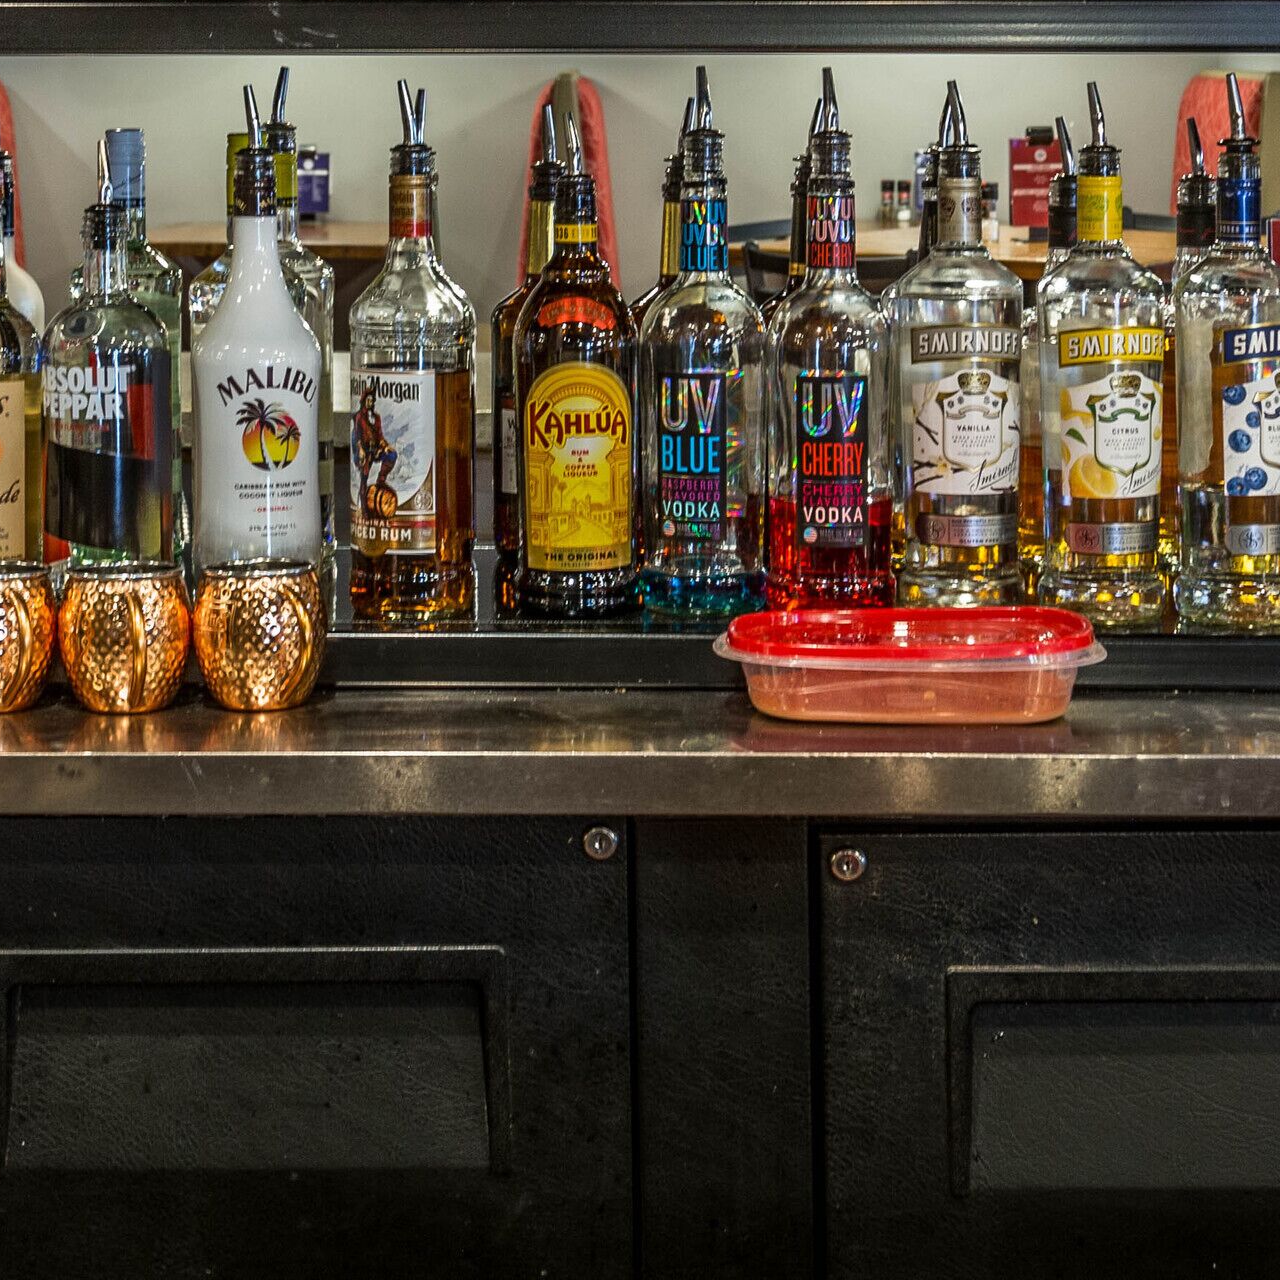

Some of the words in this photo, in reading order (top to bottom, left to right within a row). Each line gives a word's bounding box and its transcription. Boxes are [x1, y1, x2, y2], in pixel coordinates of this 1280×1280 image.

[811, 244, 854, 267] CHERRY
[919, 329, 1018, 355] SMIRNOFF
[42, 364, 136, 394] BSOLUT
[215, 365, 317, 407] MALIBU
[367, 375, 421, 404] Morgan
[42, 393, 124, 421] PEPPAR
[661, 377, 721, 435] UV
[801, 379, 864, 438] UV
[528, 399, 629, 448] KAHLÚA
[956, 424, 992, 433] VANILLA
[1111, 427, 1140, 437] CITRUS
[570, 449, 590, 457] RUM
[661, 435, 720, 474] BLUE
[802, 441, 864, 476] CHERRY
[562, 470, 599, 478] LIQUEUR
[234, 482, 274, 490] CARIBBEAN
[275, 481, 291, 489] RUM
[662, 478, 721, 491] RASPBERRY
[802, 483, 862, 497] CHERRY
[277, 489, 303, 499] LIQUEUR
[662, 490, 721, 502] FLAVORED
[662, 501, 721, 519] VODKA
[803, 506, 864, 524] VODKA
[380, 528, 412, 542] RUM
[544, 552, 564, 561] THE
[567, 551, 618, 562] ORIGINAL
